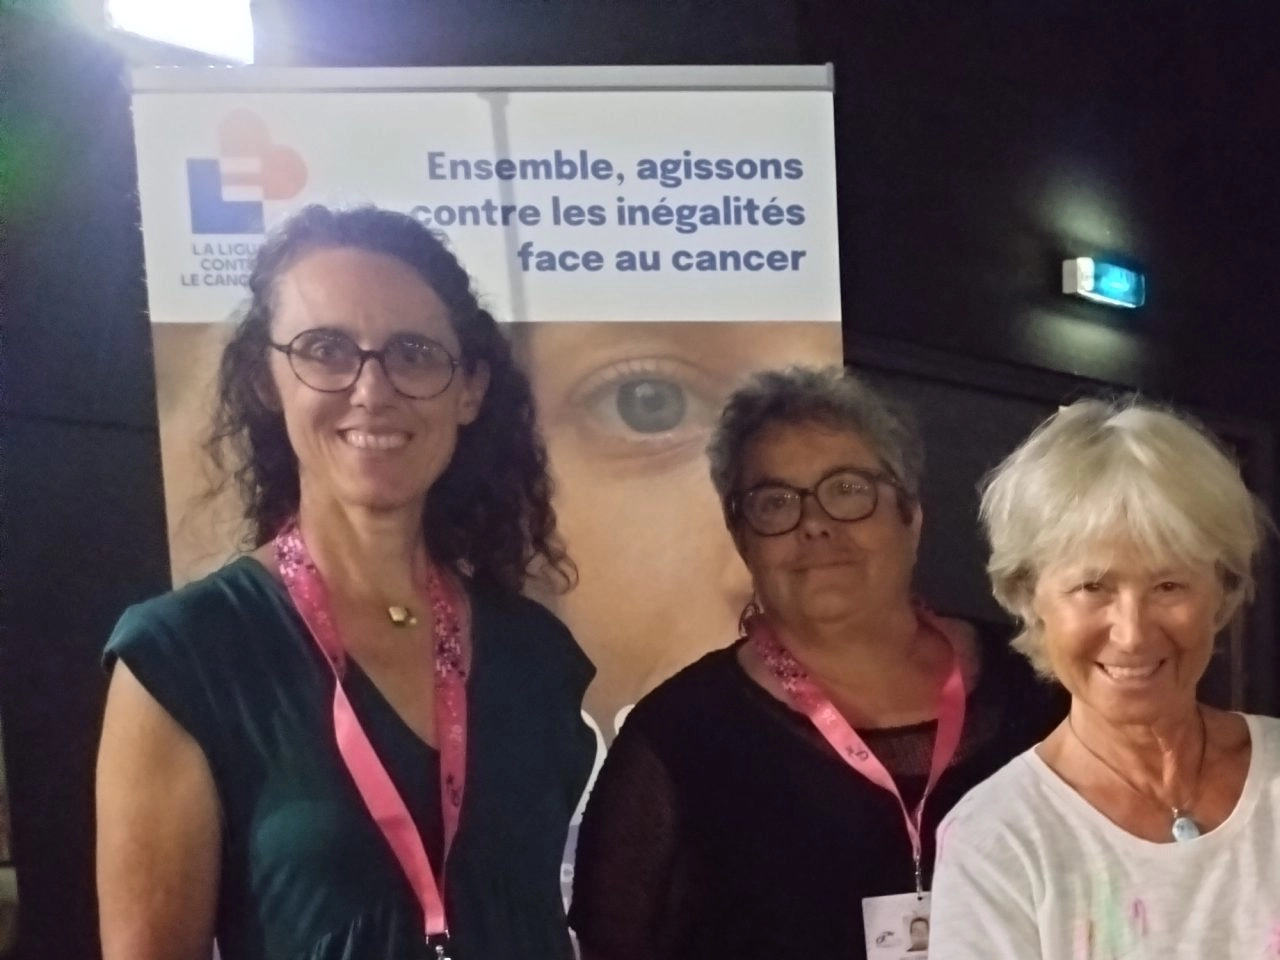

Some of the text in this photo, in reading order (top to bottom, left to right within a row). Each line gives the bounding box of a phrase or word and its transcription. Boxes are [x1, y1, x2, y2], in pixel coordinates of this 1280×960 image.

[427, 149, 804, 188] Ensemble, agissons
[411, 195, 806, 234] contre les inégalités
[193, 243, 258, 256] LA LIGU
[517, 241, 807, 272] face au cancer
[200, 258, 252, 271] CONT
[181, 273, 250, 287] LE CANC
